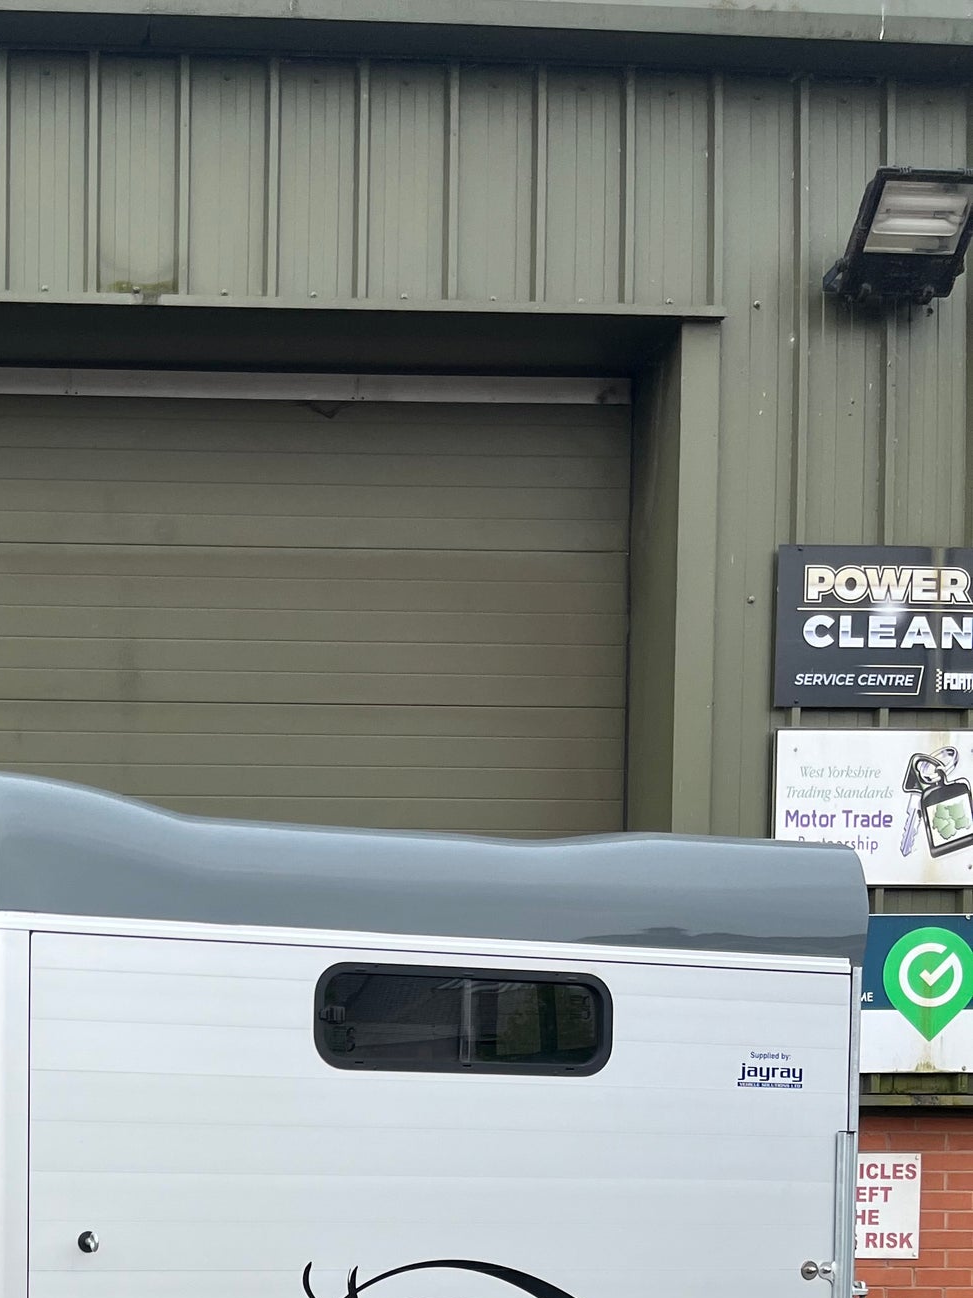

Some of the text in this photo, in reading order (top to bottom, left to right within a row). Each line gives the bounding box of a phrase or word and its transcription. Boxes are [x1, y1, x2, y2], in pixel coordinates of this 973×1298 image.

[804, 565, 973, 604] POWER
[803, 615, 973, 649] CLEAN
[794, 673, 915, 687] SERVICE CENTRE
[800, 765, 881, 778] West Yorkshire
[787, 786, 893, 802] Trading Standards
[785, 809, 893, 828] Motor Trade
[750, 1051, 780, 1060] Supplied
[738, 1063, 803, 1082] jayray
[865, 1232, 913, 1249] RISK
